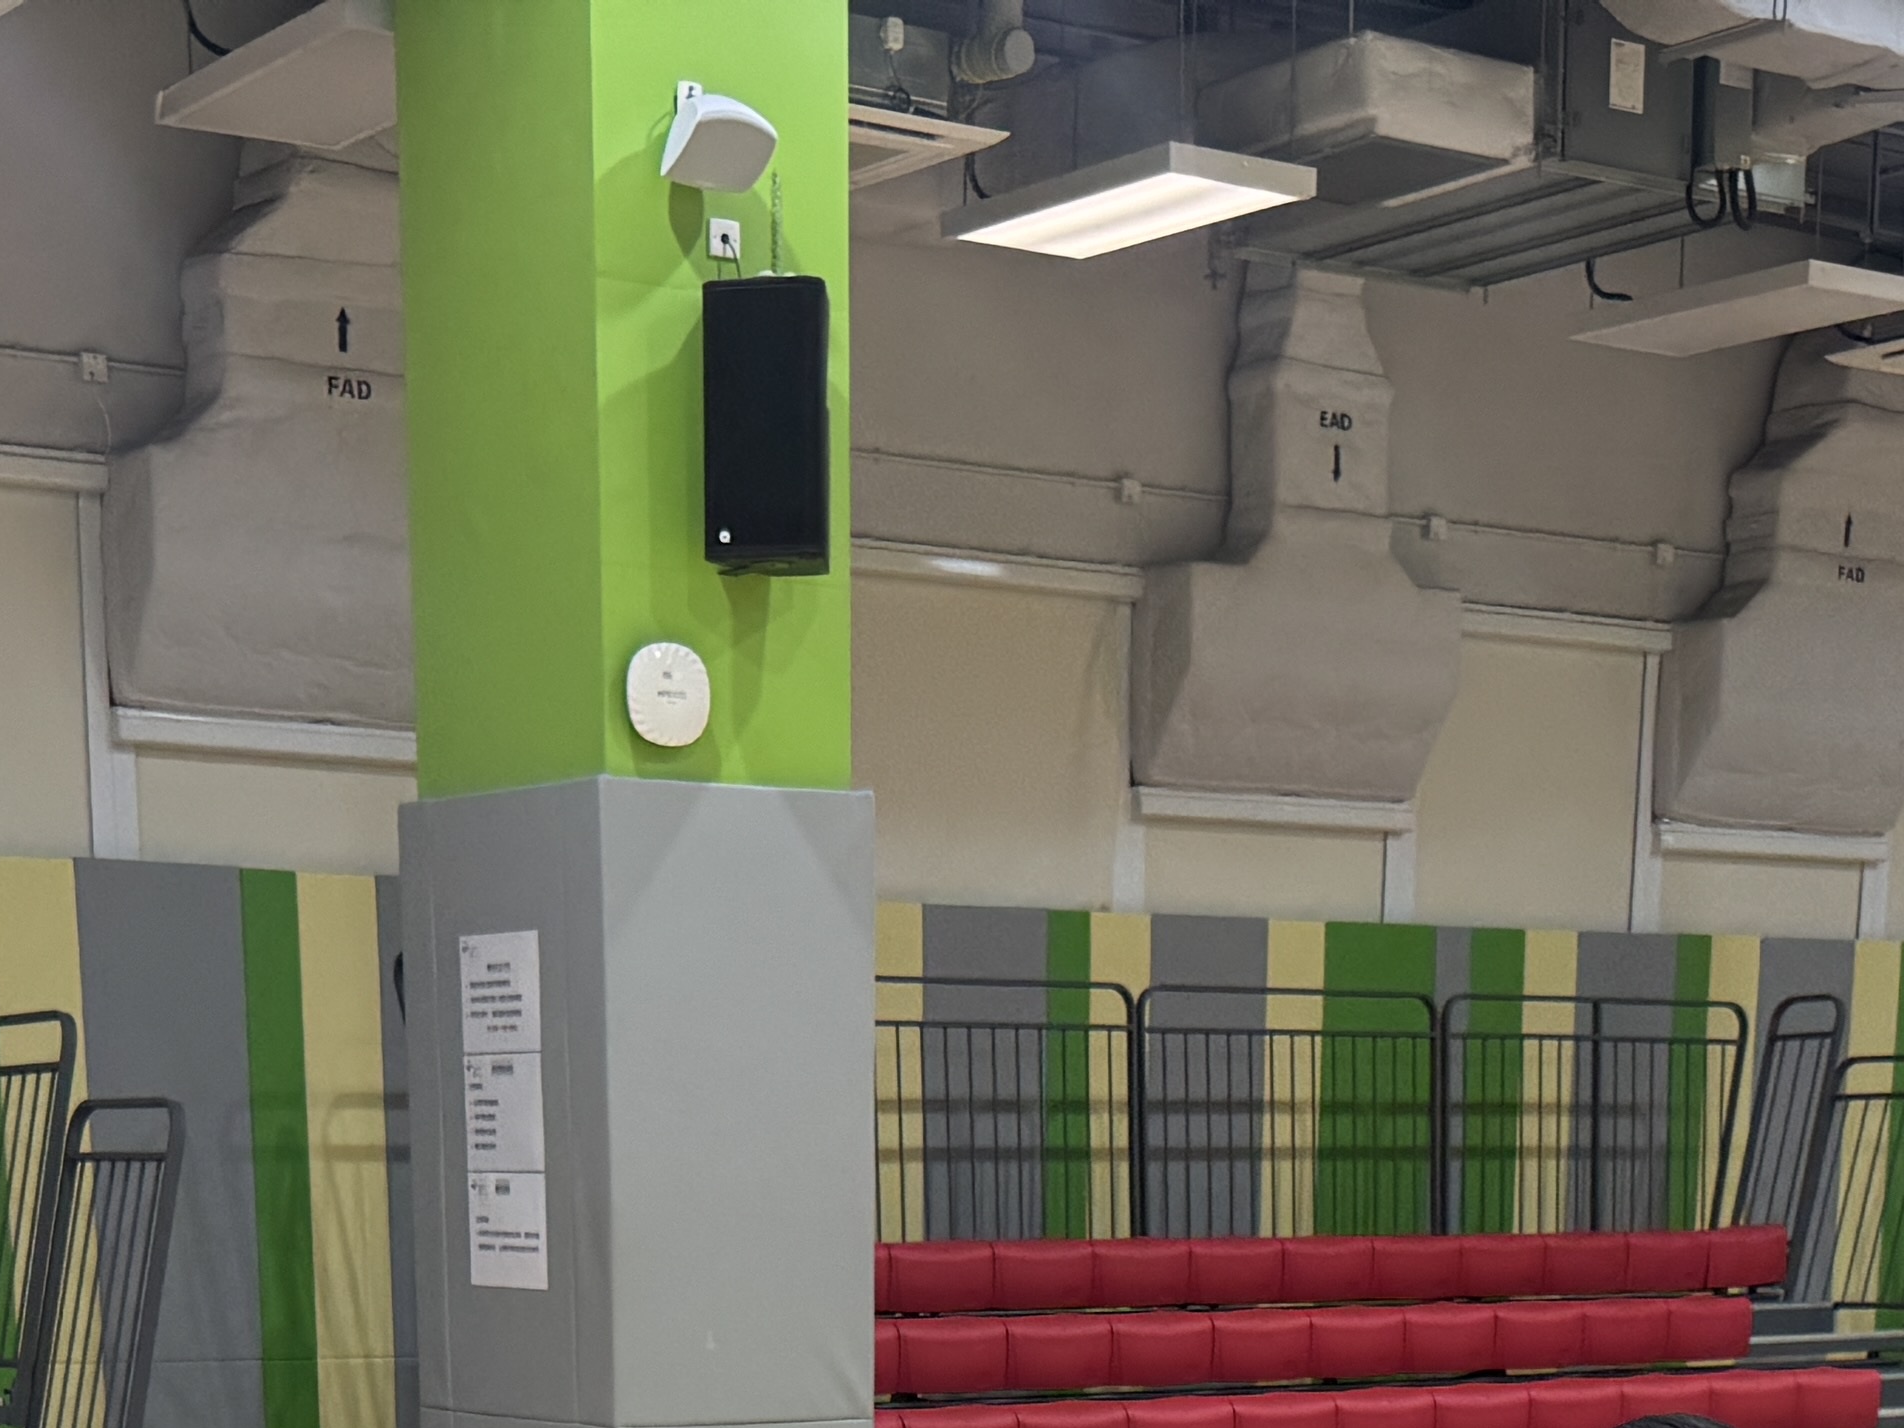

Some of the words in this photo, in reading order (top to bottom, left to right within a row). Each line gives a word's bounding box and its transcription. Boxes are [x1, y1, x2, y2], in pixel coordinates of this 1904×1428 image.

[327, 375, 372, 400] FAD
[1319, 410, 1353, 431] EAD
[1838, 564, 1865, 583] FAD
